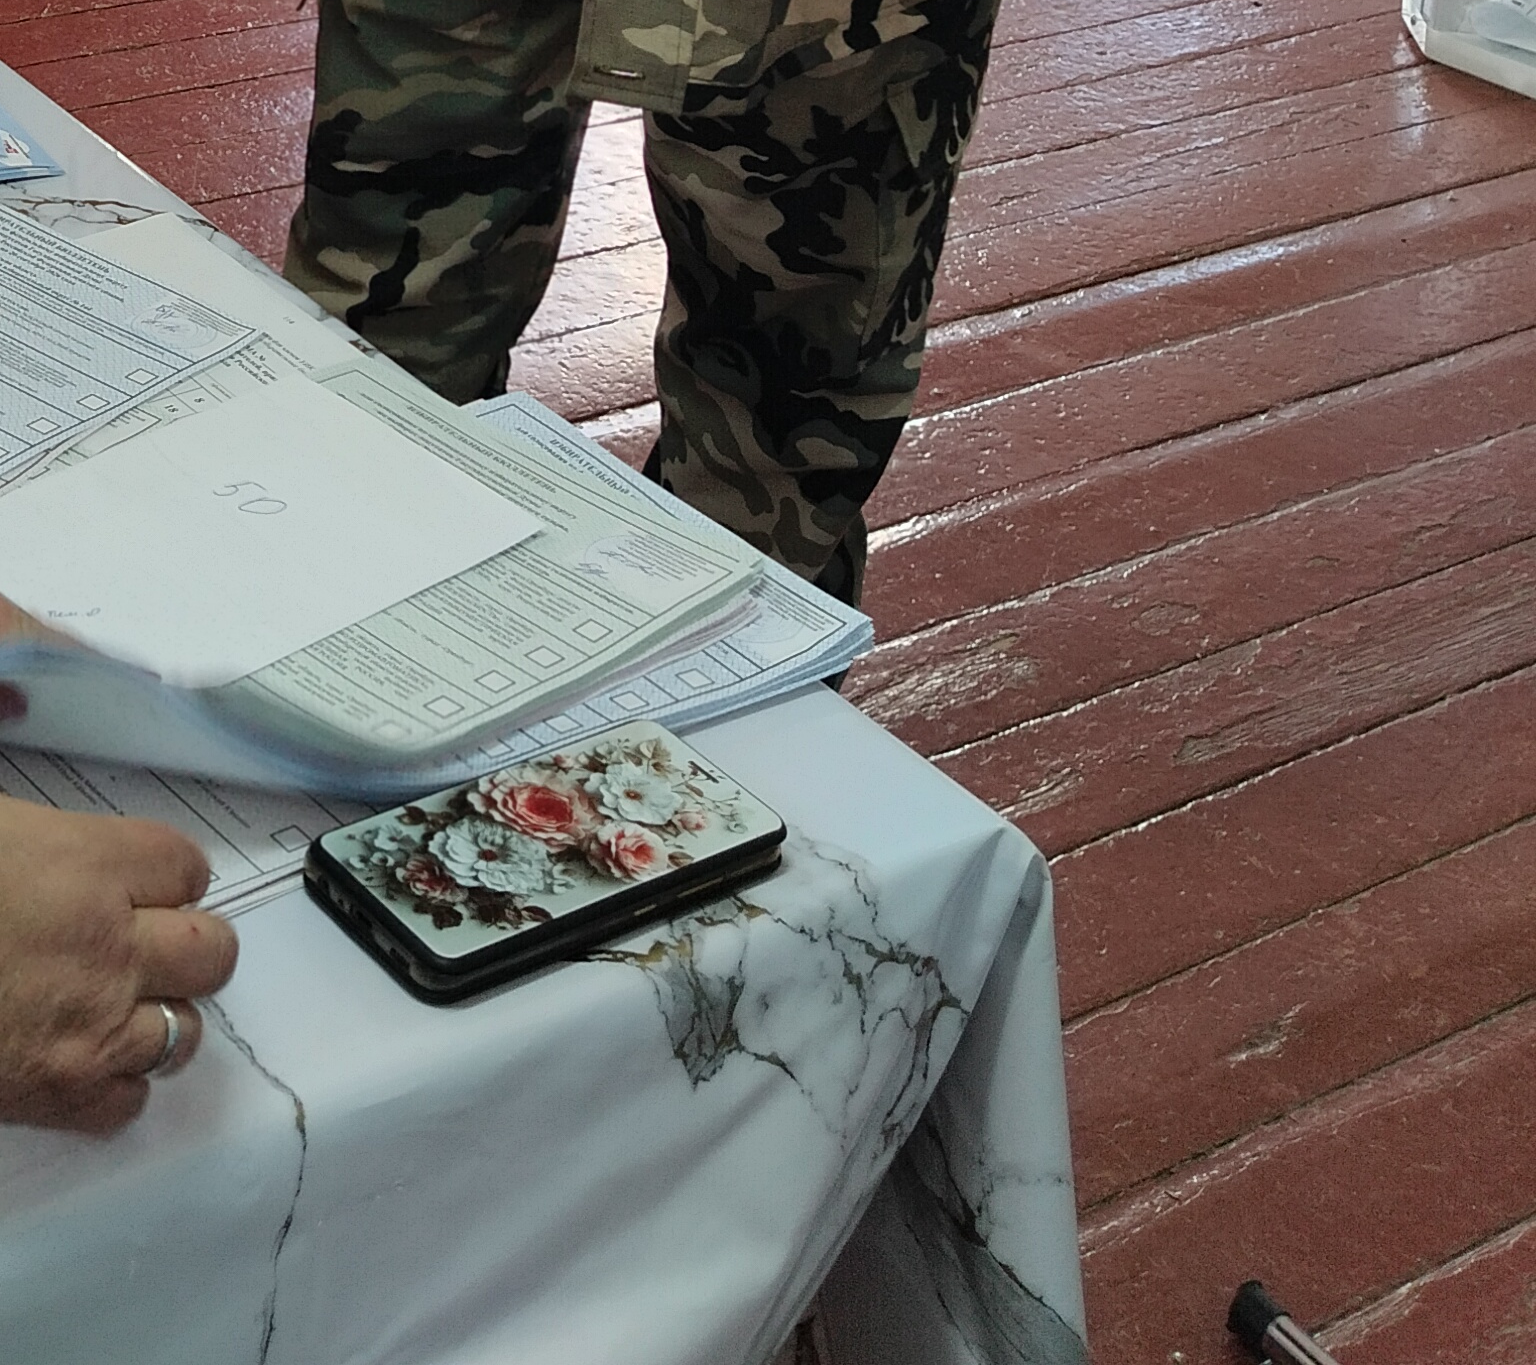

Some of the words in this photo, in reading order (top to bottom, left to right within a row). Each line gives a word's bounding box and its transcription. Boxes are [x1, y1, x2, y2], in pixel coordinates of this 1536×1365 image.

[194, 396, 205, 404] 8
[165, 403, 179, 414] 18
[212, 481, 288, 515] 50
